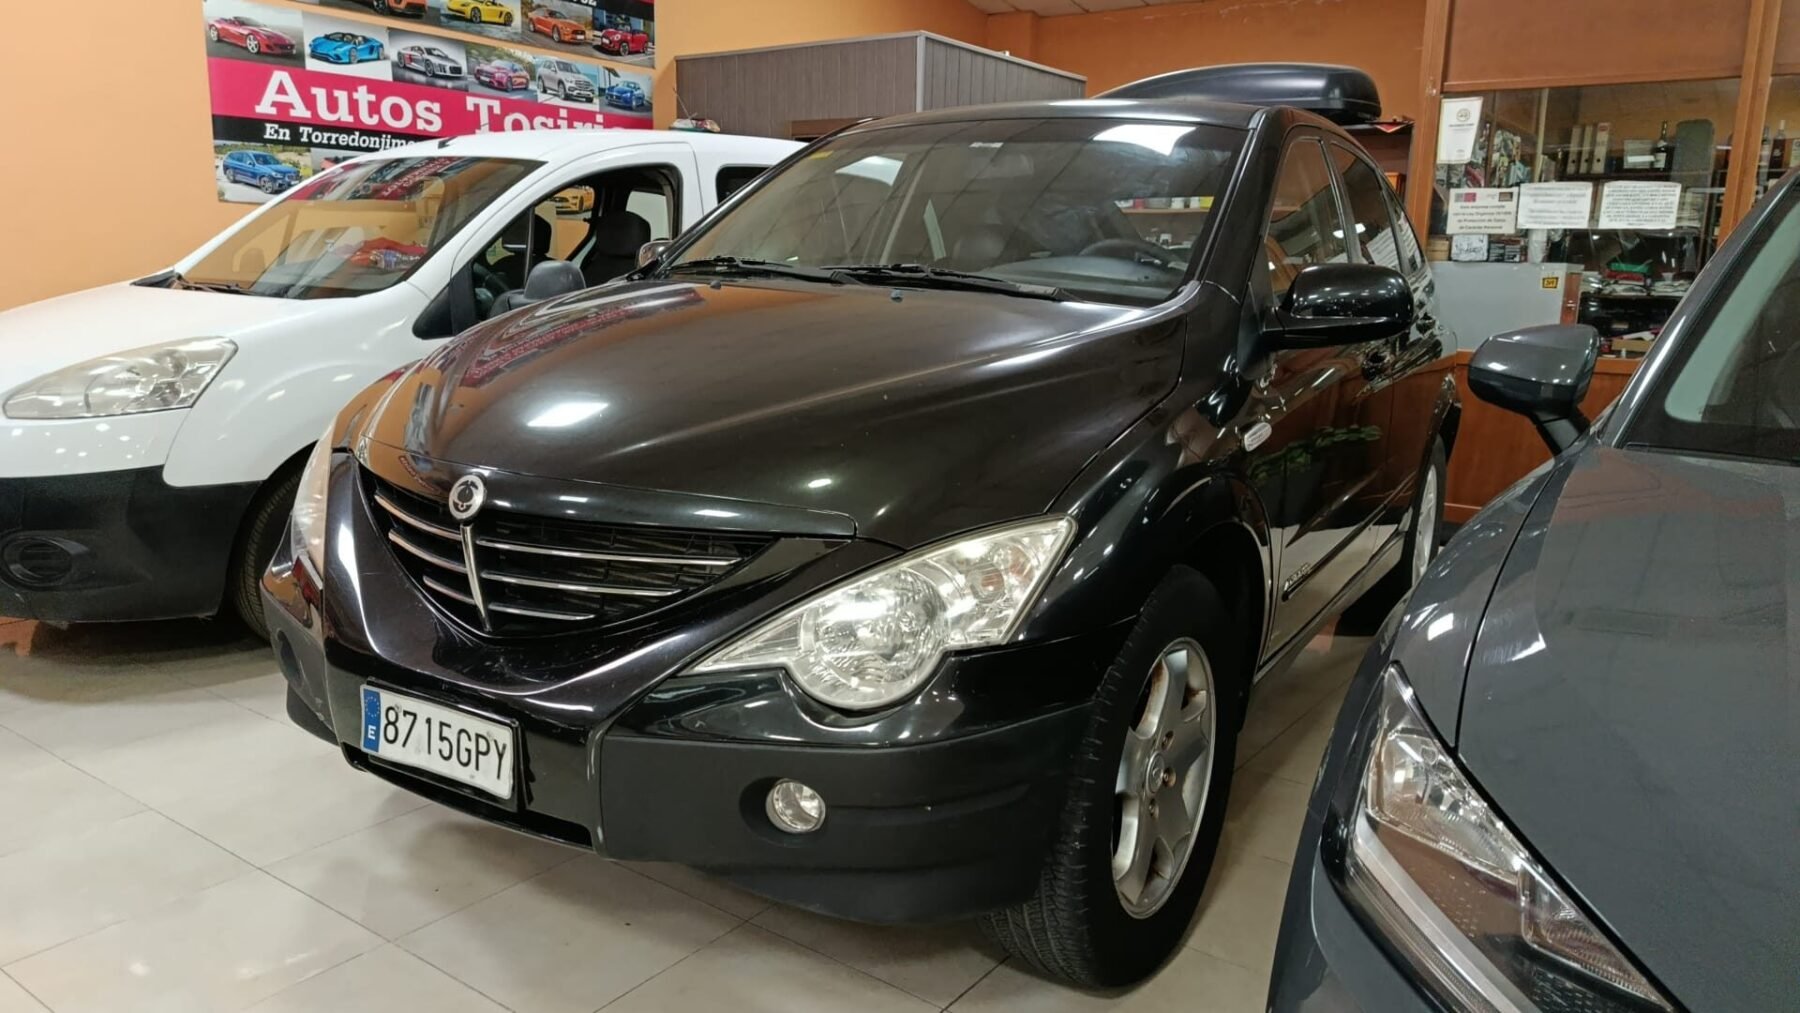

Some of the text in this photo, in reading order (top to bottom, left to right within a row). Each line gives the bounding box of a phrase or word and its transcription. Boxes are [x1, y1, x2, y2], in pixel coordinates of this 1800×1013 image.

[254, 69, 443, 132] Autos
[263, 122, 291, 141] En
[367, 724, 377, 740] E
[383, 705, 507, 780] 8715GPY
